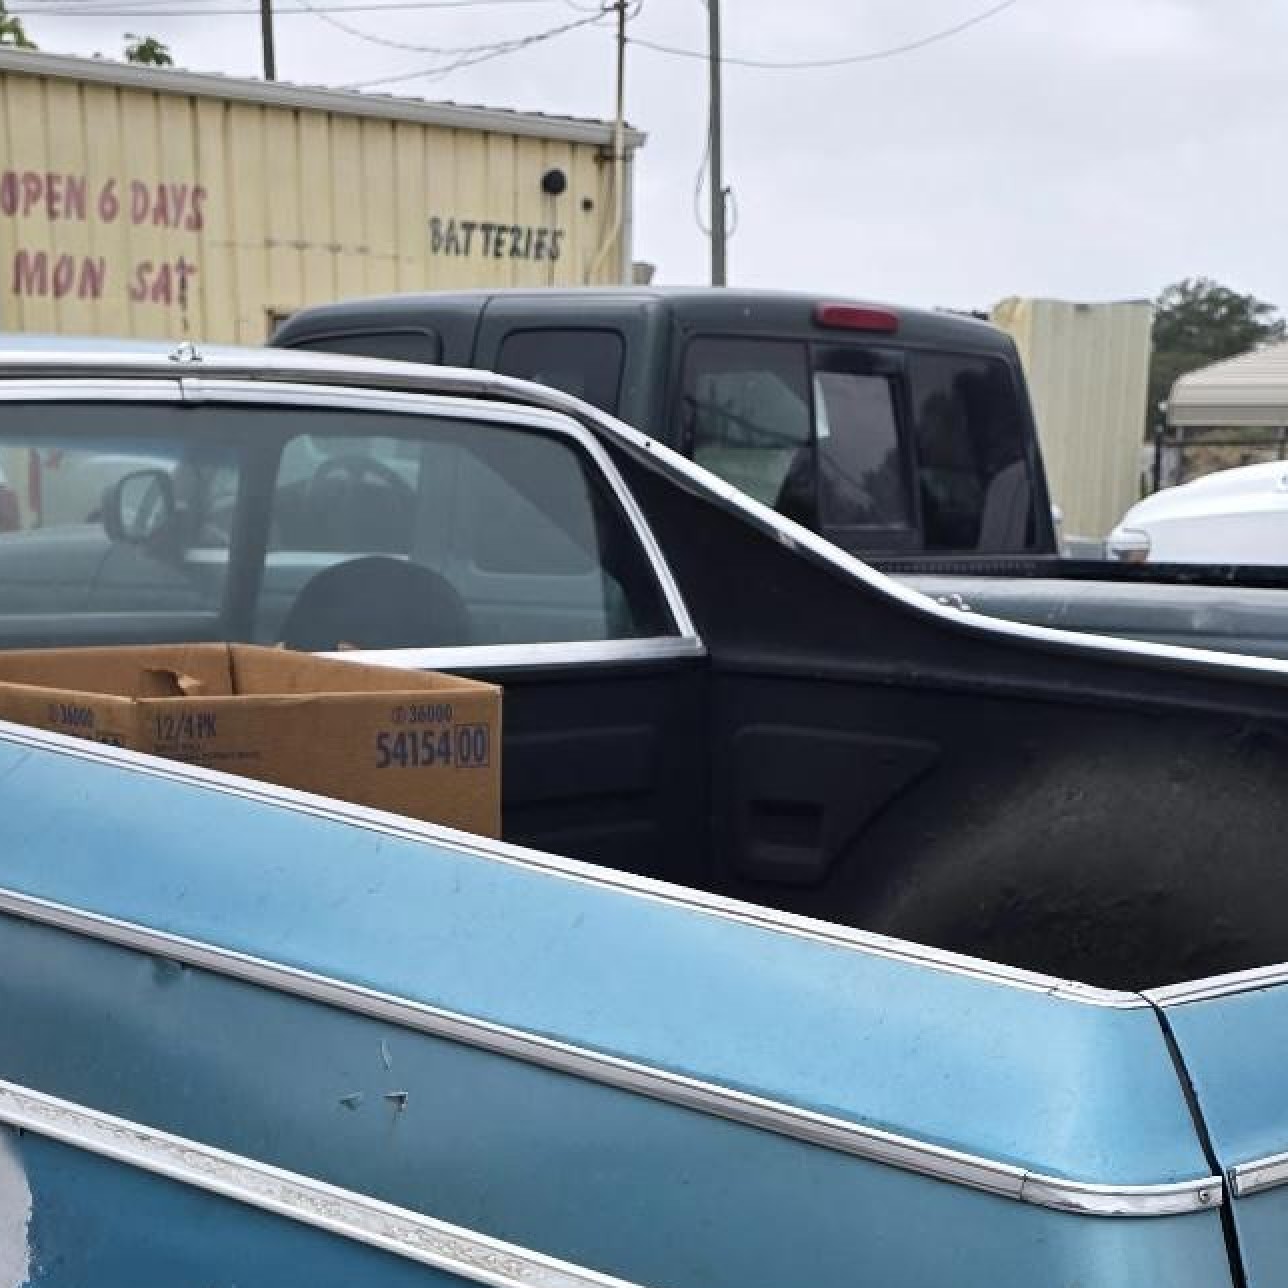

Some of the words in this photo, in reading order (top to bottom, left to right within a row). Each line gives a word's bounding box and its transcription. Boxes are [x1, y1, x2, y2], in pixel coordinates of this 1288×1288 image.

[97, 177, 121, 224] 6
[130, 179, 208, 231] DAYS
[429, 216, 566, 262] BATTERIES
[12, 249, 107, 300] MON
[128, 256, 199, 311] SAT
[409, 703, 453, 722] 36000
[375, 729, 451, 769] 54154
